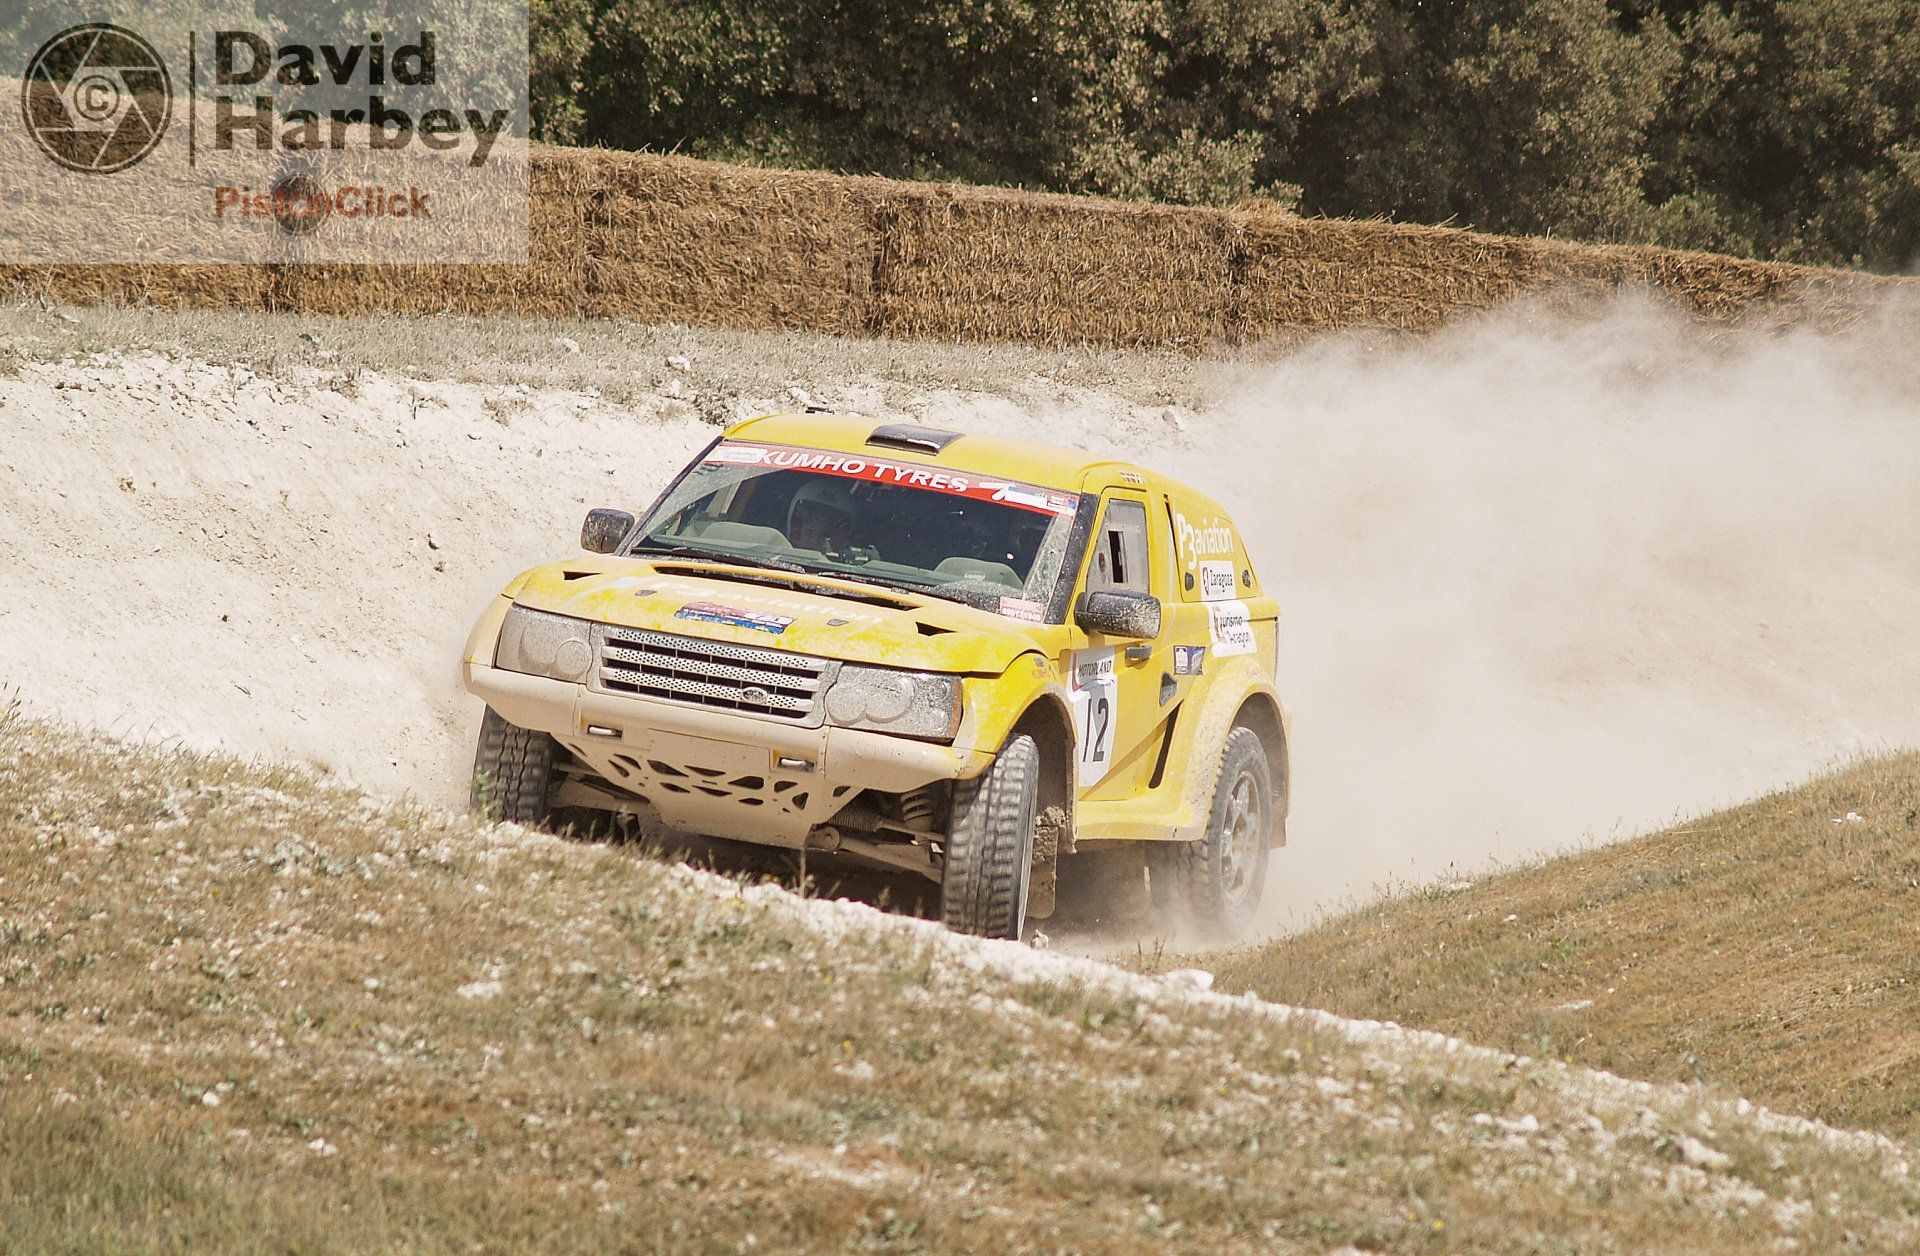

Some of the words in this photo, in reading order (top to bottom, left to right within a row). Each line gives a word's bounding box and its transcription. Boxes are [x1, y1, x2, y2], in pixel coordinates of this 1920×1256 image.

[758, 448, 866, 475] KUMHO
[873, 463, 970, 492] TYRES
[1082, 697, 1110, 763] 12
